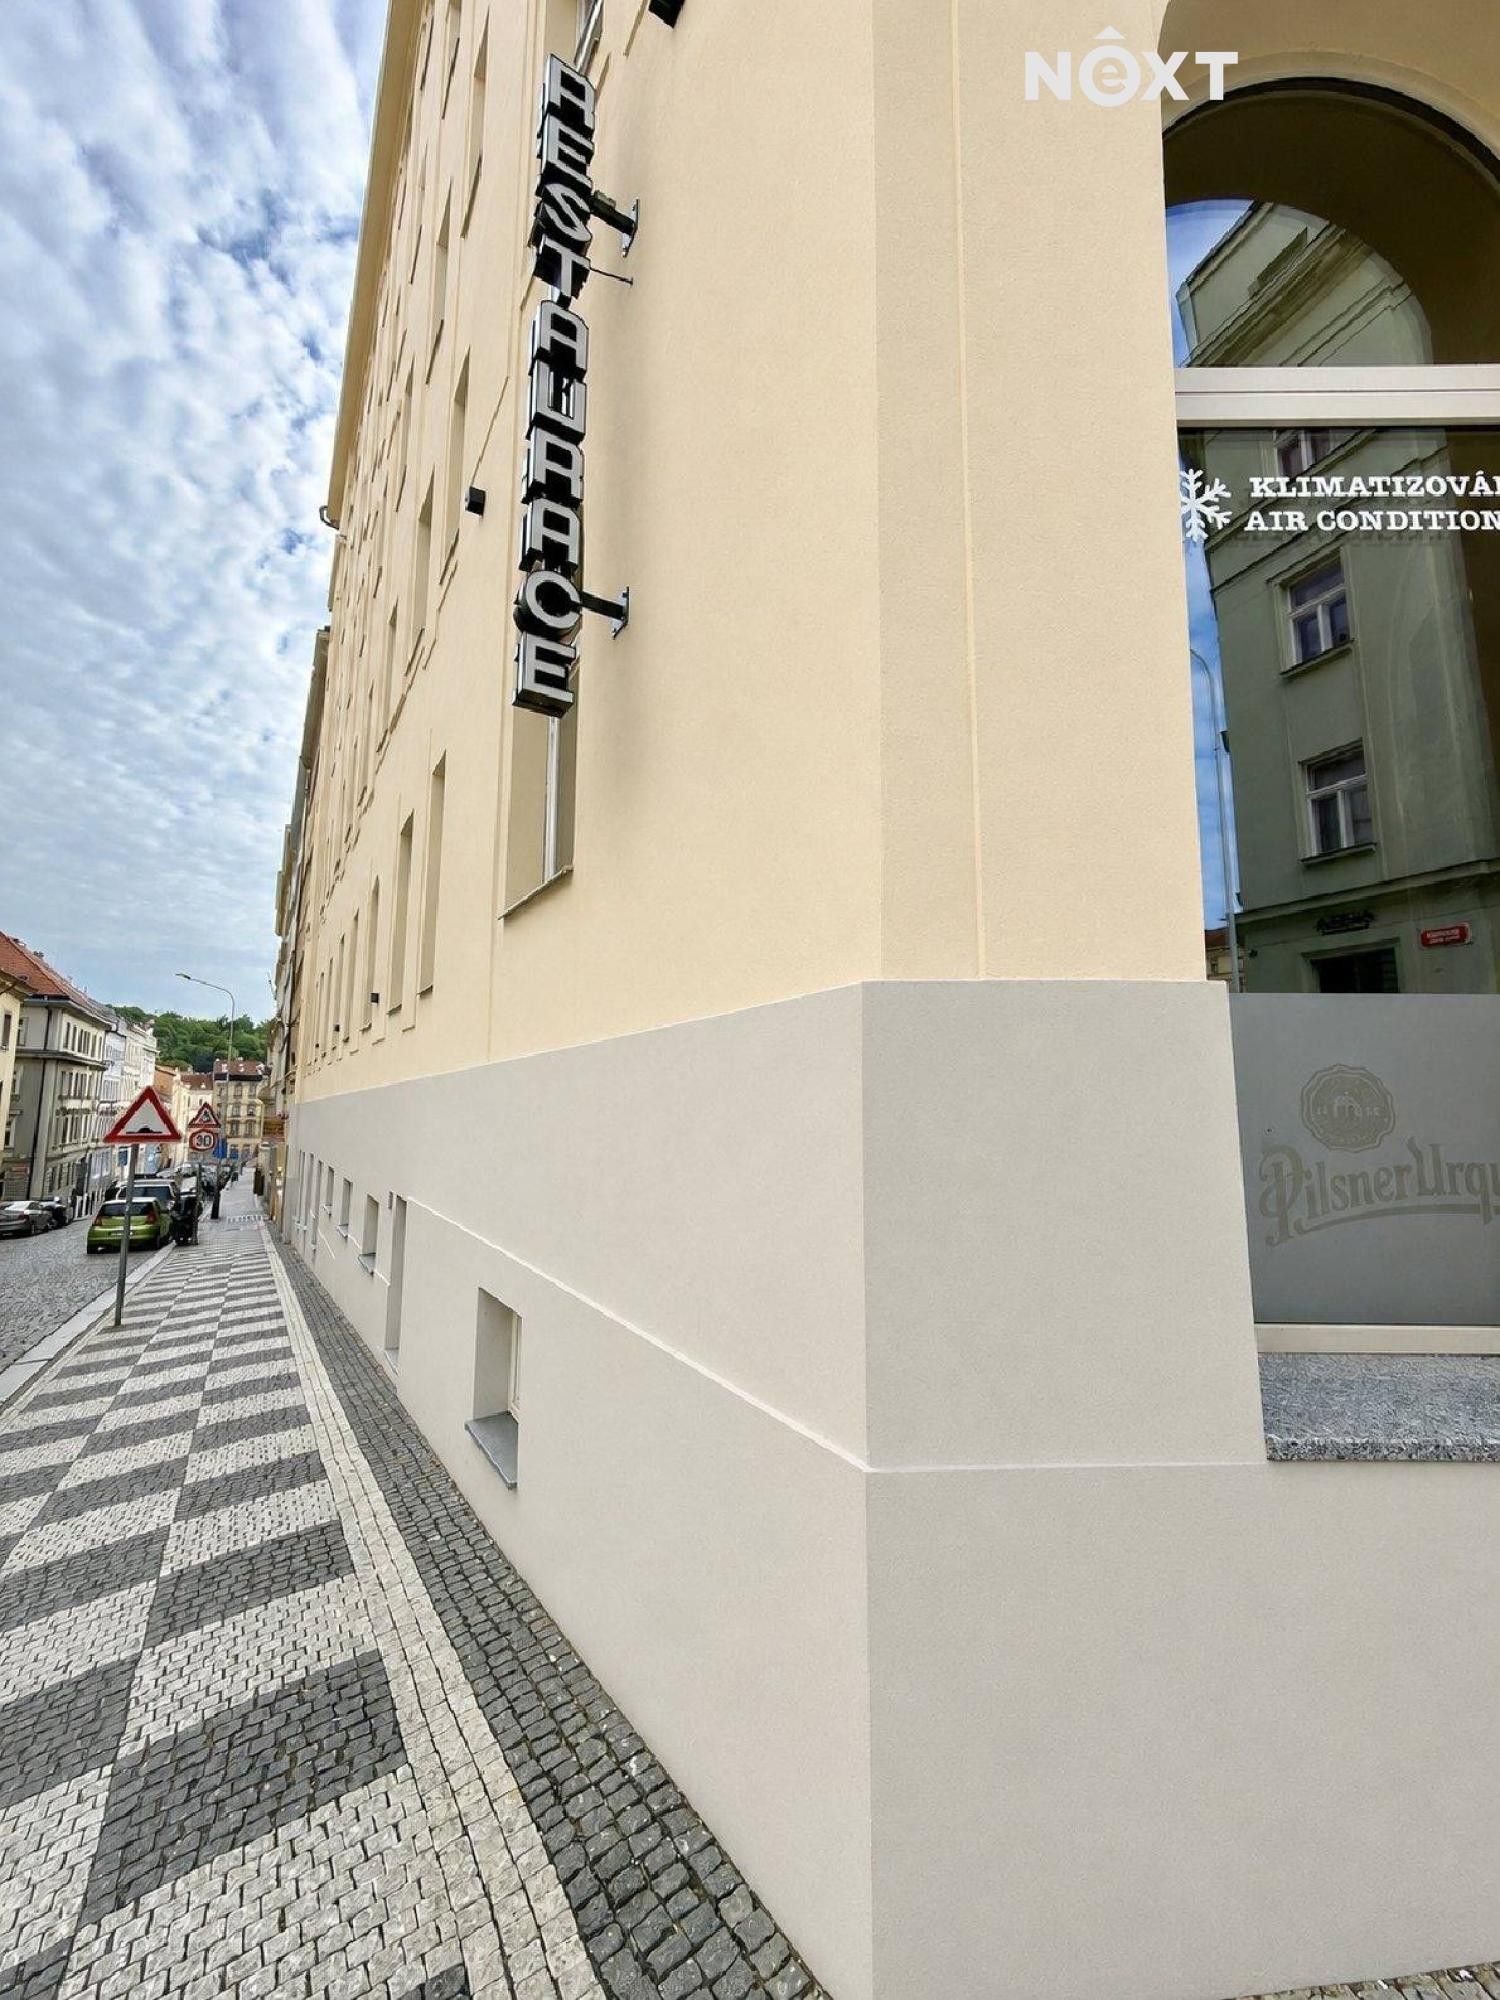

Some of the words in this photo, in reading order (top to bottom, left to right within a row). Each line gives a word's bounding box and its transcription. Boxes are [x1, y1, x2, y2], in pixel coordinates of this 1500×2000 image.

[514, 53, 596, 715] RESTAURACE
[1244, 510, 1308, 531] AIR
[196, 1135, 212, 1147] 30
[1259, 1143, 1412, 1248] Pilsner
